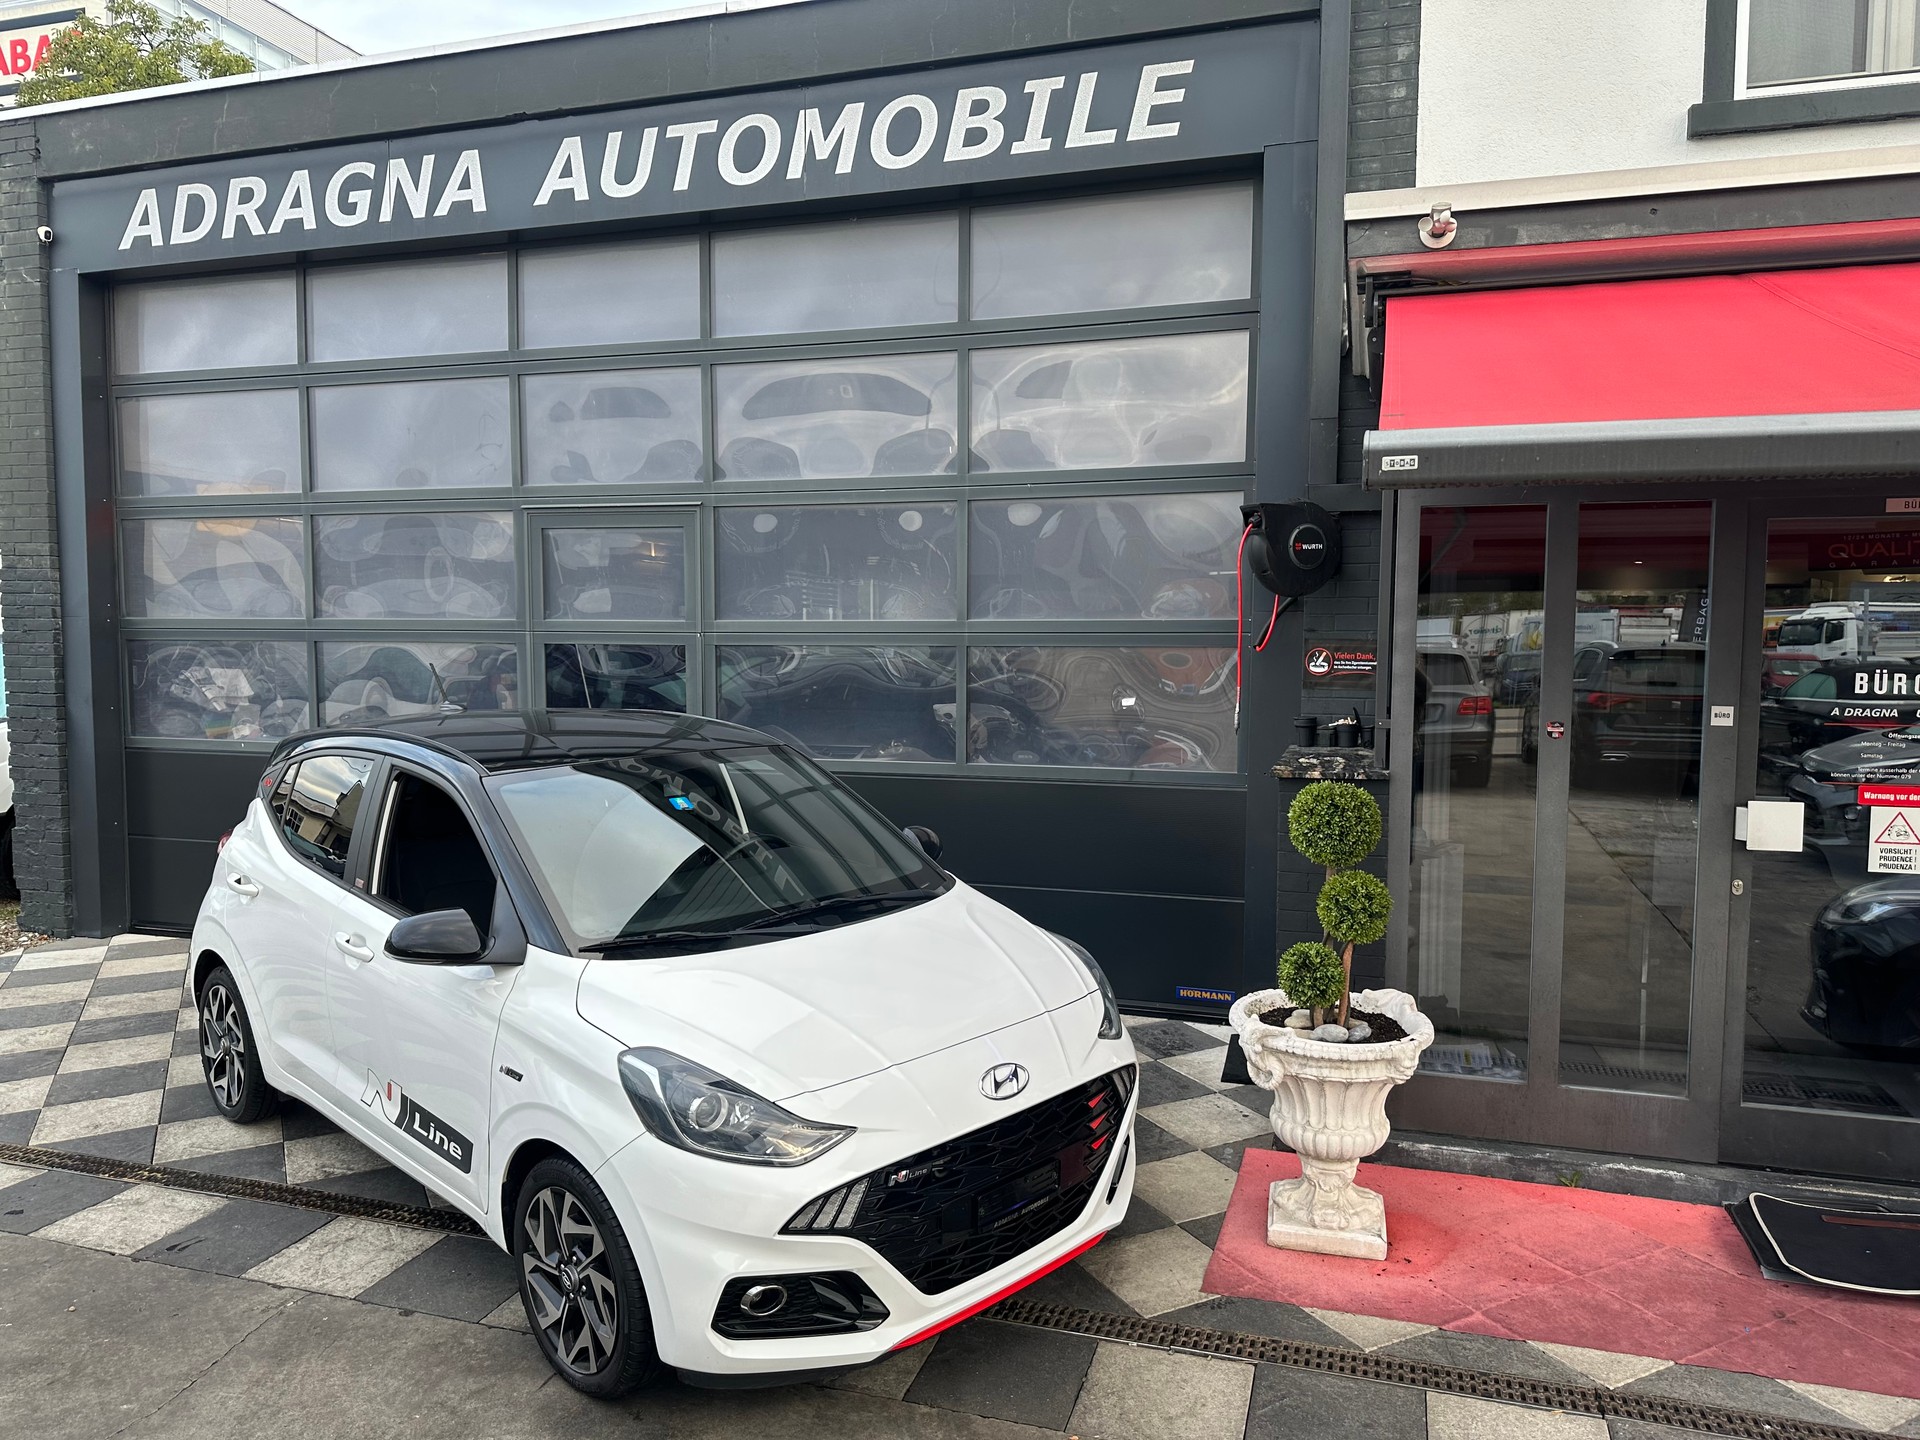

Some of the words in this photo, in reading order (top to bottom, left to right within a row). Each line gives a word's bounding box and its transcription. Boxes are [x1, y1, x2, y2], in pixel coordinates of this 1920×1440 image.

[118, 148, 488, 252] ADRAGNA
[532, 59, 1195, 207] AUTOMOBILE
[1904, 499, 1920, 509] BÜ
[1714, 711, 1731, 719] BÜRO
[1864, 792, 1894, 801] Warnung
[412, 1111, 463, 1161] Line
